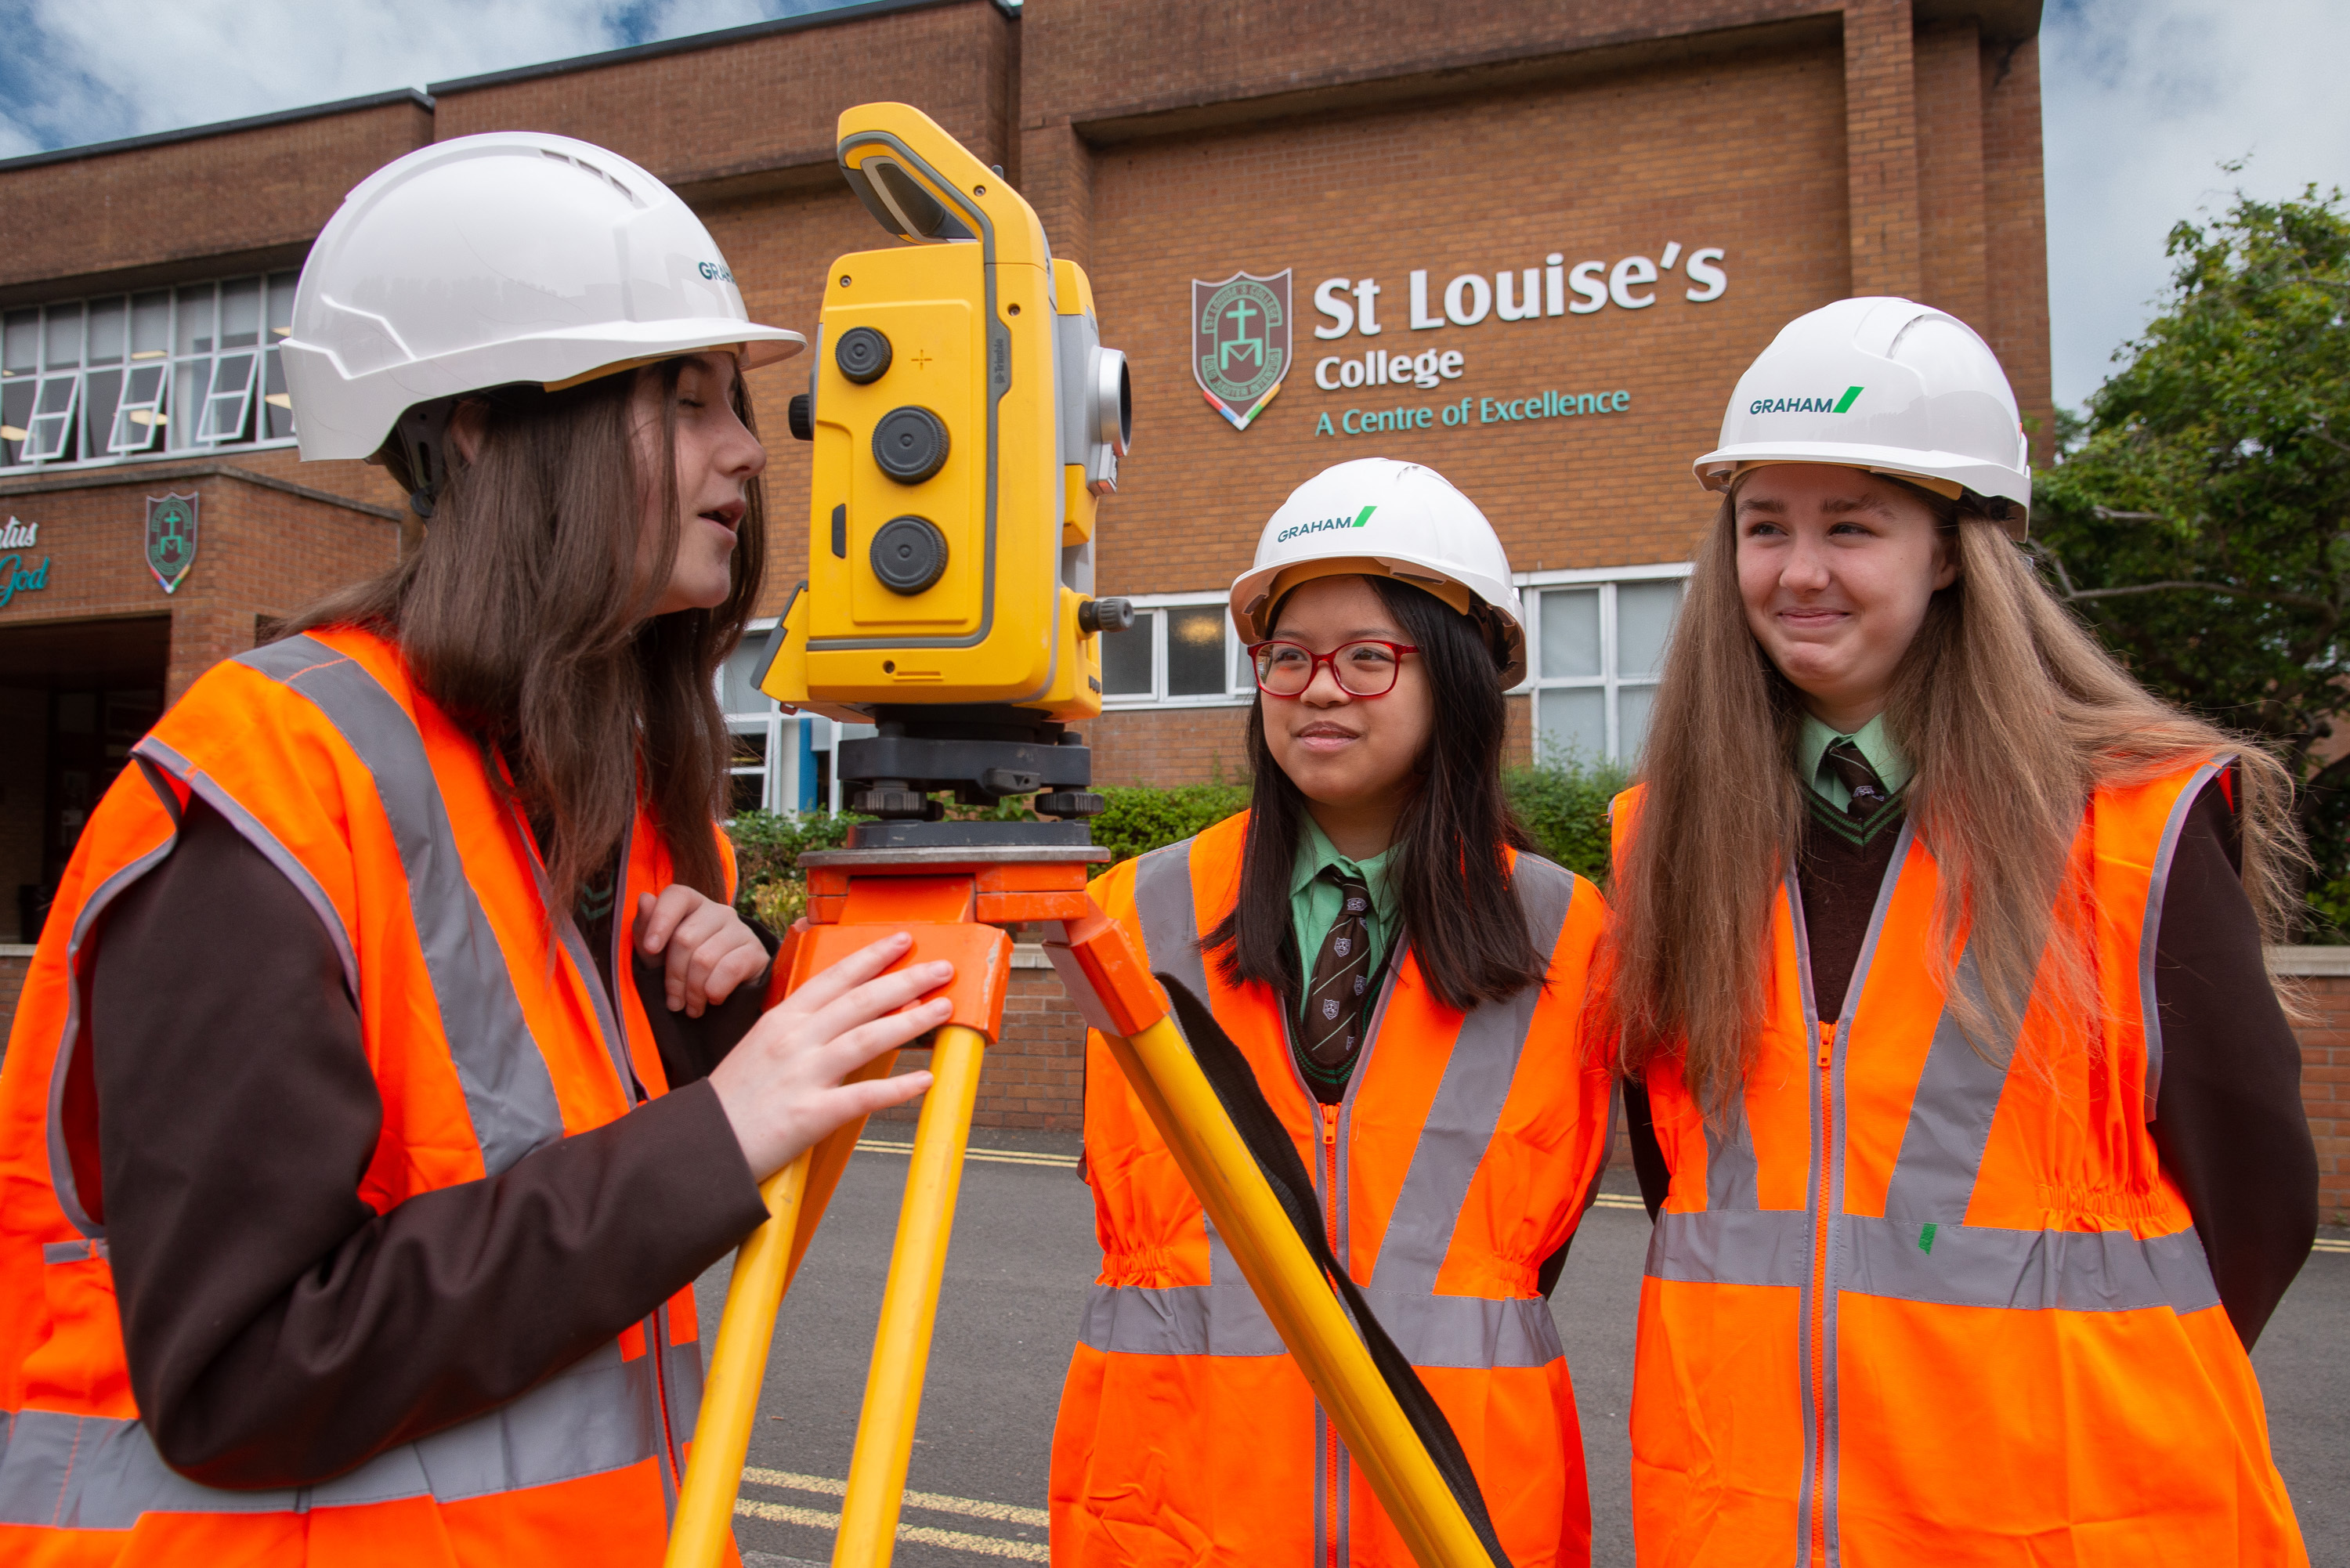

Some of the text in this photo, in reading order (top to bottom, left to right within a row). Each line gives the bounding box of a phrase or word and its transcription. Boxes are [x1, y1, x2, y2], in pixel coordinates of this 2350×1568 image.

[1314, 241, 1728, 340] St Louise's
[1314, 348, 1465, 390] College
[1314, 388, 1631, 437] A Centre of Excellence
[1750, 398, 1834, 415] GRAHAM
[1278, 516, 1352, 543] GRAHAM
